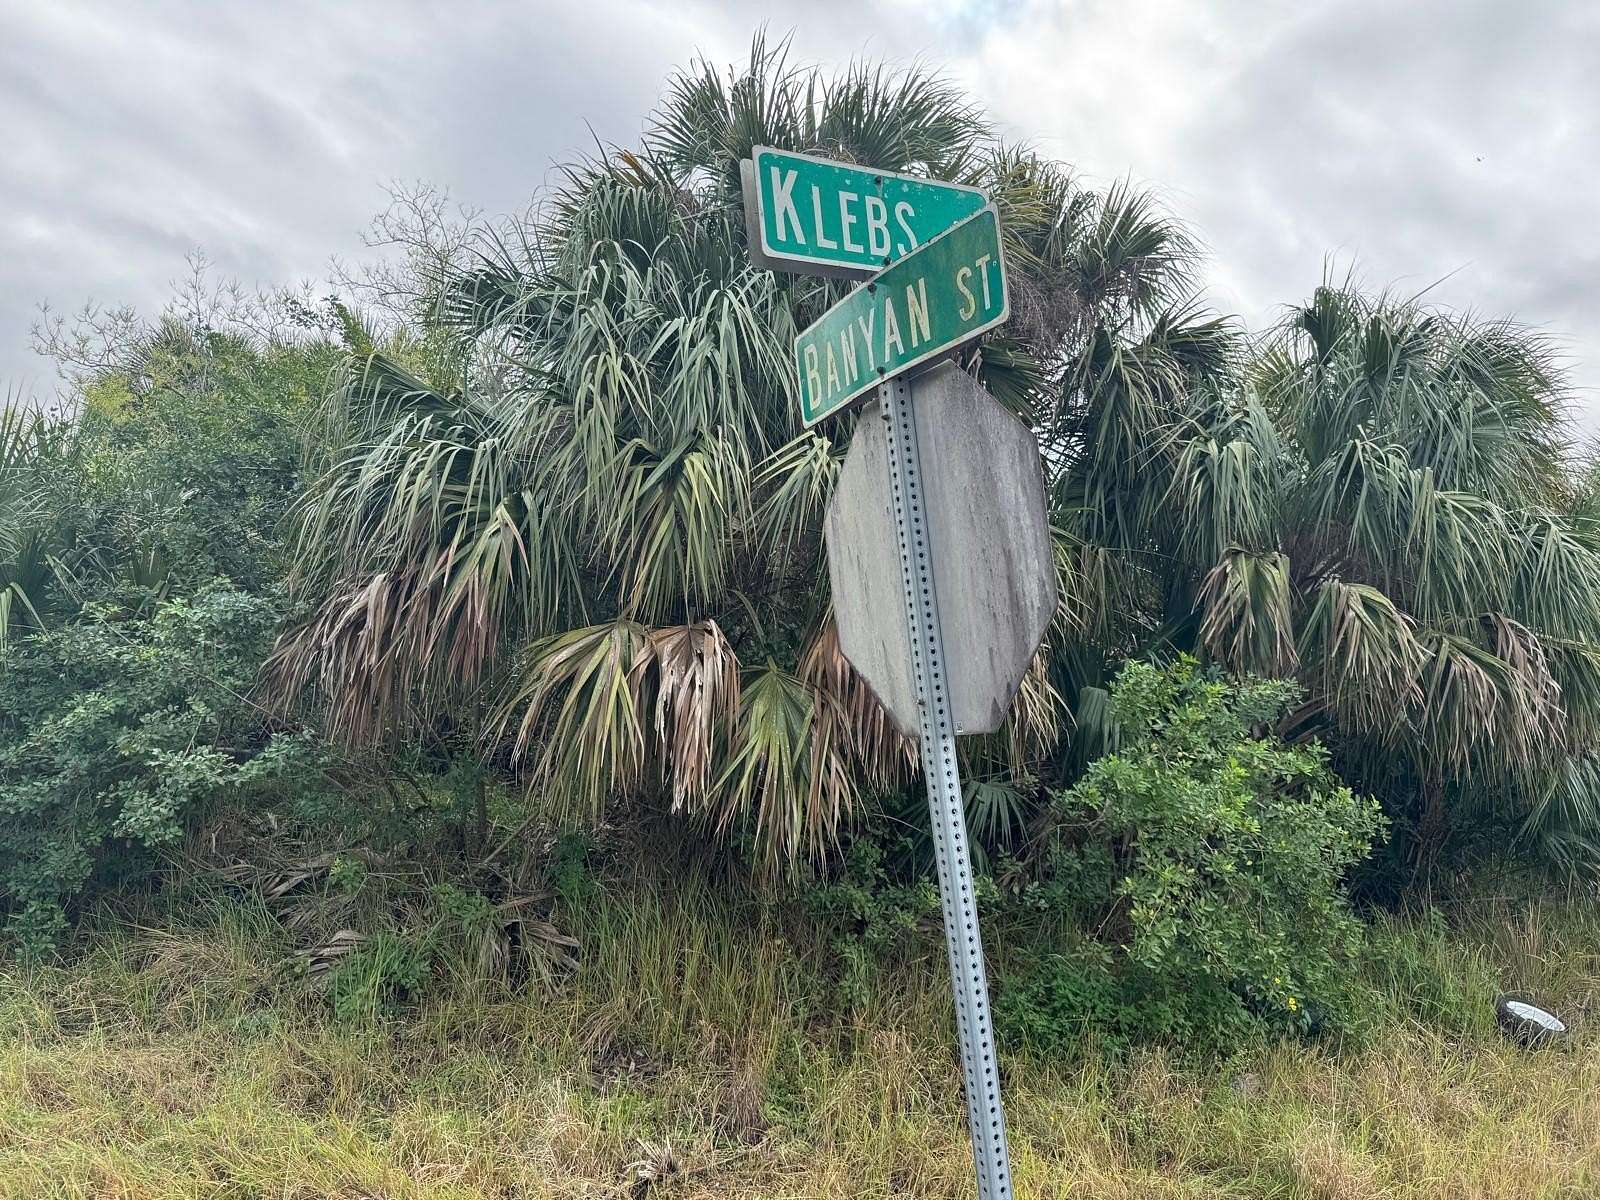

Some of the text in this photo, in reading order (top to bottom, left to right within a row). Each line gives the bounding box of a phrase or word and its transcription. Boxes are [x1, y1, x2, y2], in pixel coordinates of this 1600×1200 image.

[770, 166, 918, 257] KLEBS
[803, 254, 992, 412] BANYAN ST
